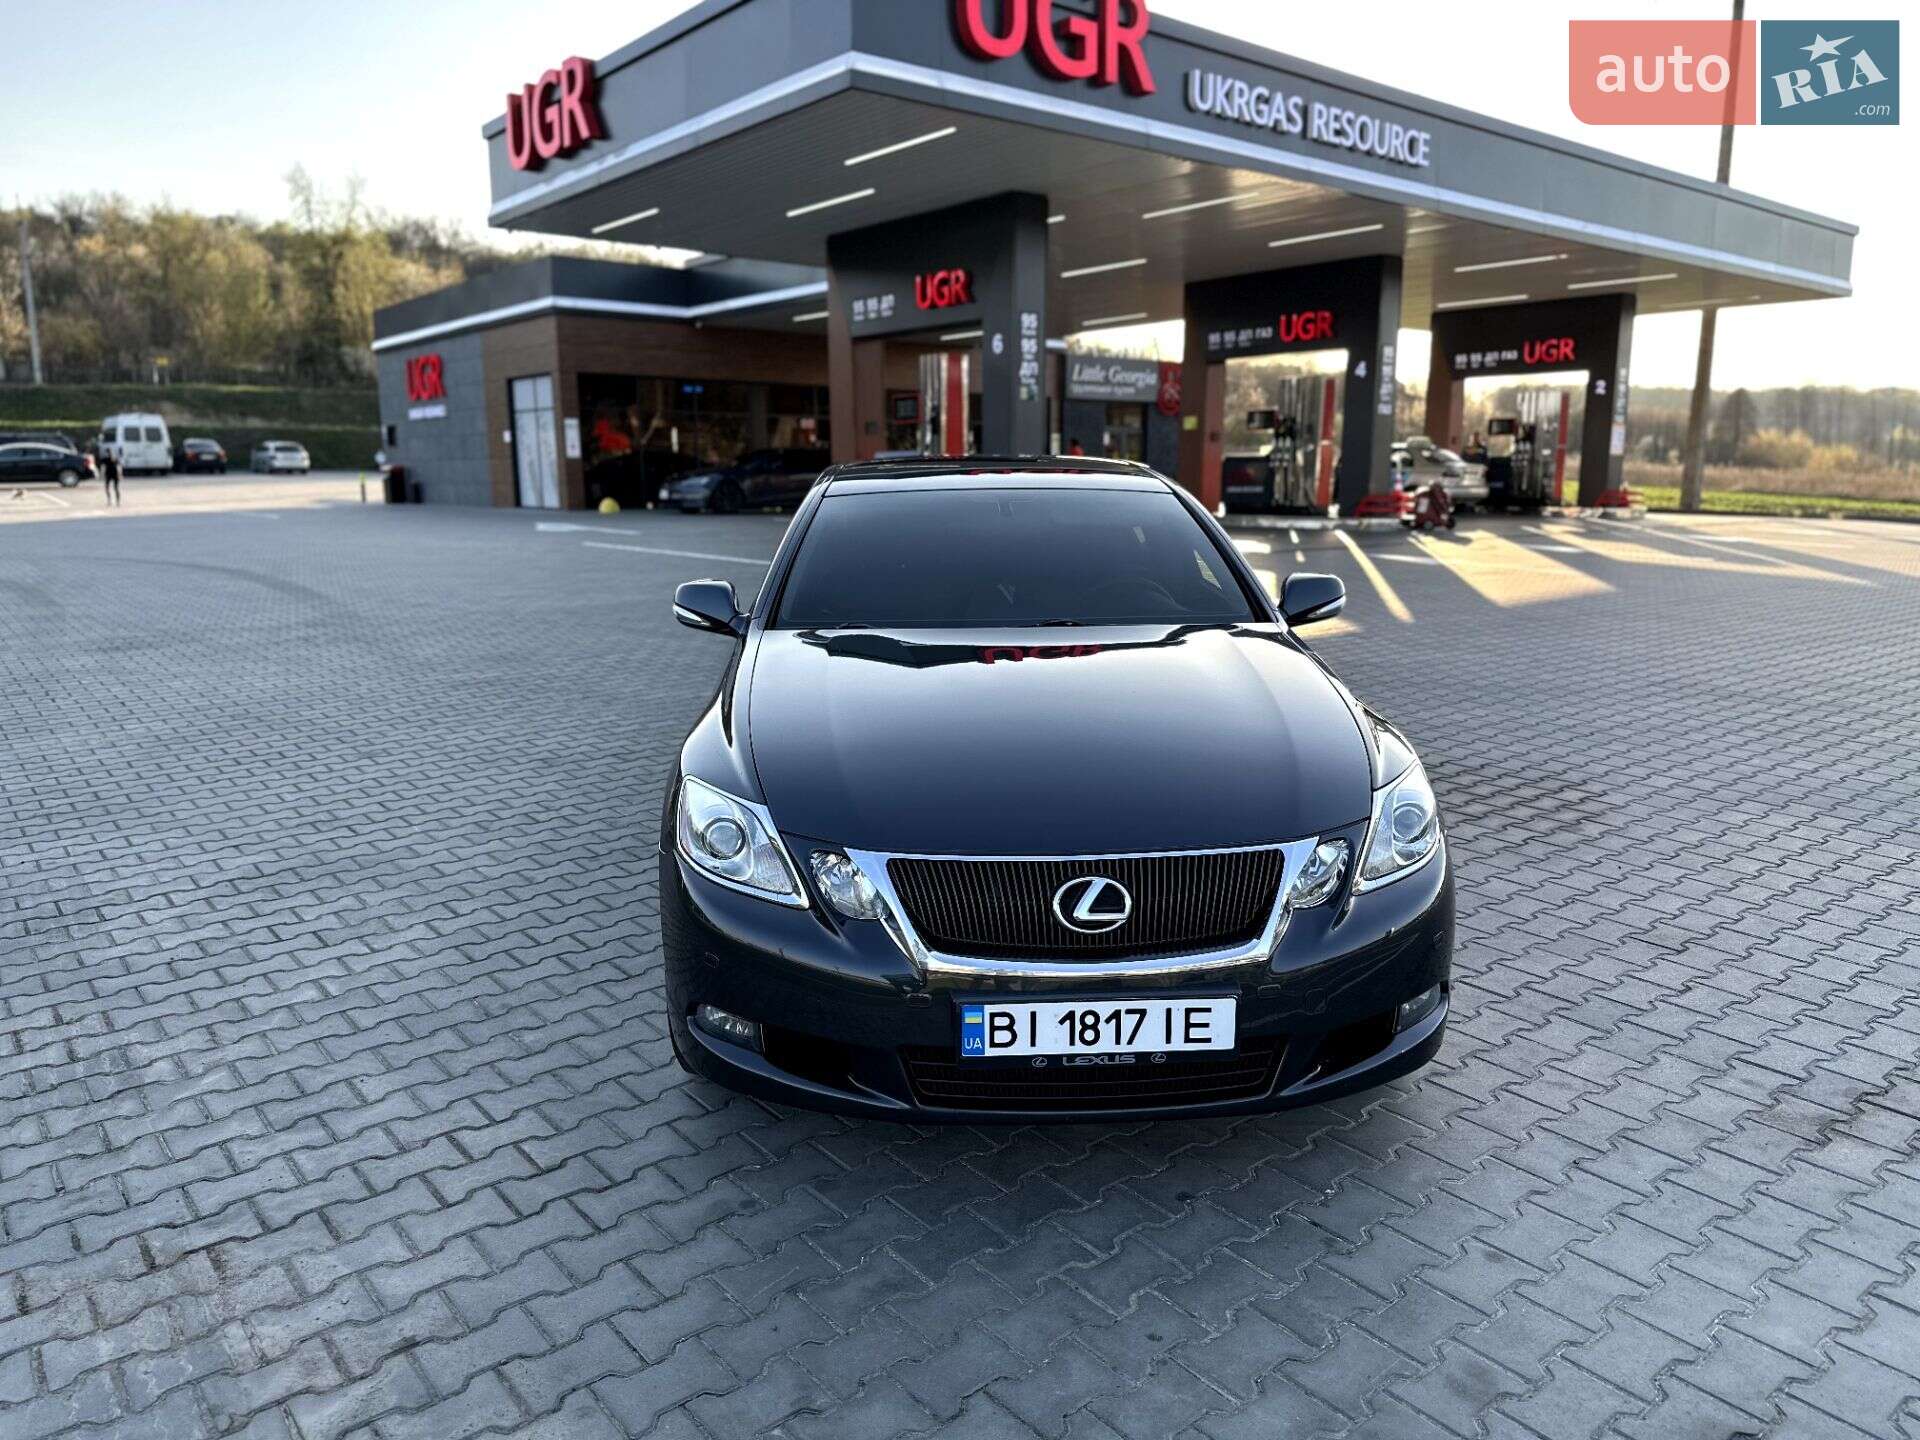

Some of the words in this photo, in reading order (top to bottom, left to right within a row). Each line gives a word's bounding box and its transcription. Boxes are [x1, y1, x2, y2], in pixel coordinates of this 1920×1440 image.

[957, 0, 1156, 93] UGR
[506, 56, 598, 171] UGR
[1188, 69, 1304, 134] UKRGAS
[1308, 101, 1431, 167] RESOURCE
[915, 268, 970, 310] UGR
[1279, 311, 1334, 342] UGR
[992, 333, 1004, 354] 6
[1523, 337, 1575, 365] UGR
[407, 354, 446, 400] UGR
[1355, 361, 1367, 378] 4
[1595, 380, 1606, 395] 2
[989, 1011, 1037, 1048] BI
[1058, 1008, 1147, 1046] 1817
[1165, 1007, 1212, 1045] IE
[964, 1038, 982, 1049] UA
[1063, 1054, 1136, 1066] LEXUS
